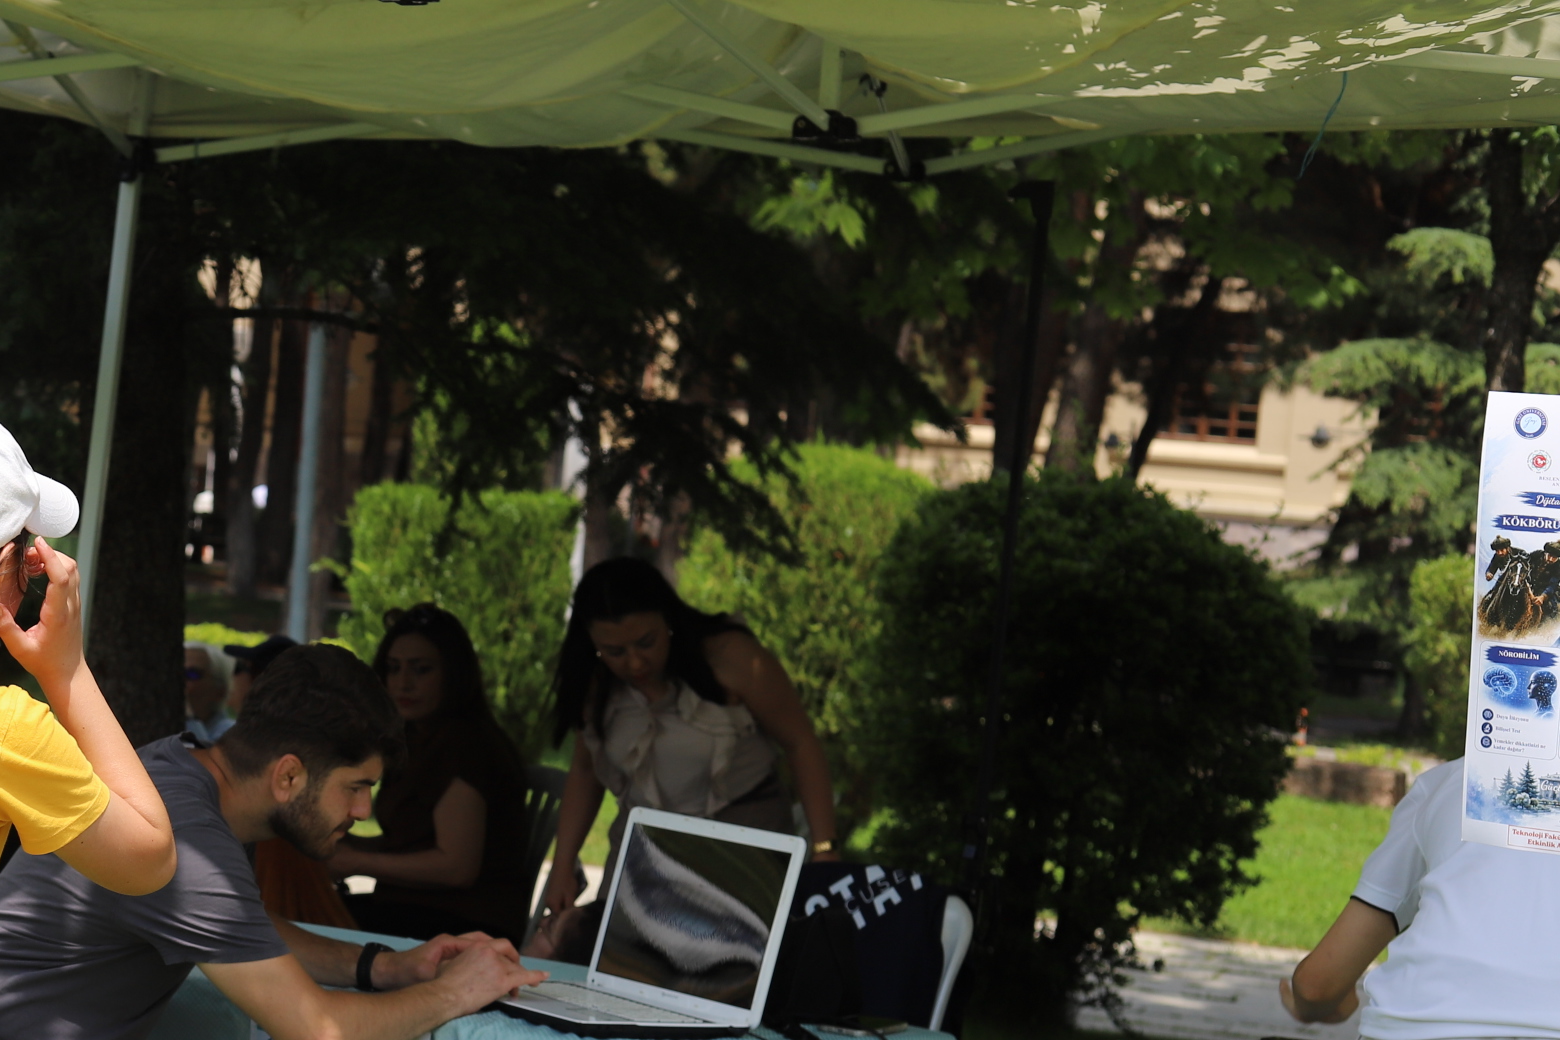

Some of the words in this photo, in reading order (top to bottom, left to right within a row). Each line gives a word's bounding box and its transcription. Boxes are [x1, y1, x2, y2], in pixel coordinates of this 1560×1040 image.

[1498, 650, 1540, 660] NÖROBİLİM
[1512, 828, 1543, 839] Teknoloji
[1527, 839, 1556, 848] Etkinlik
